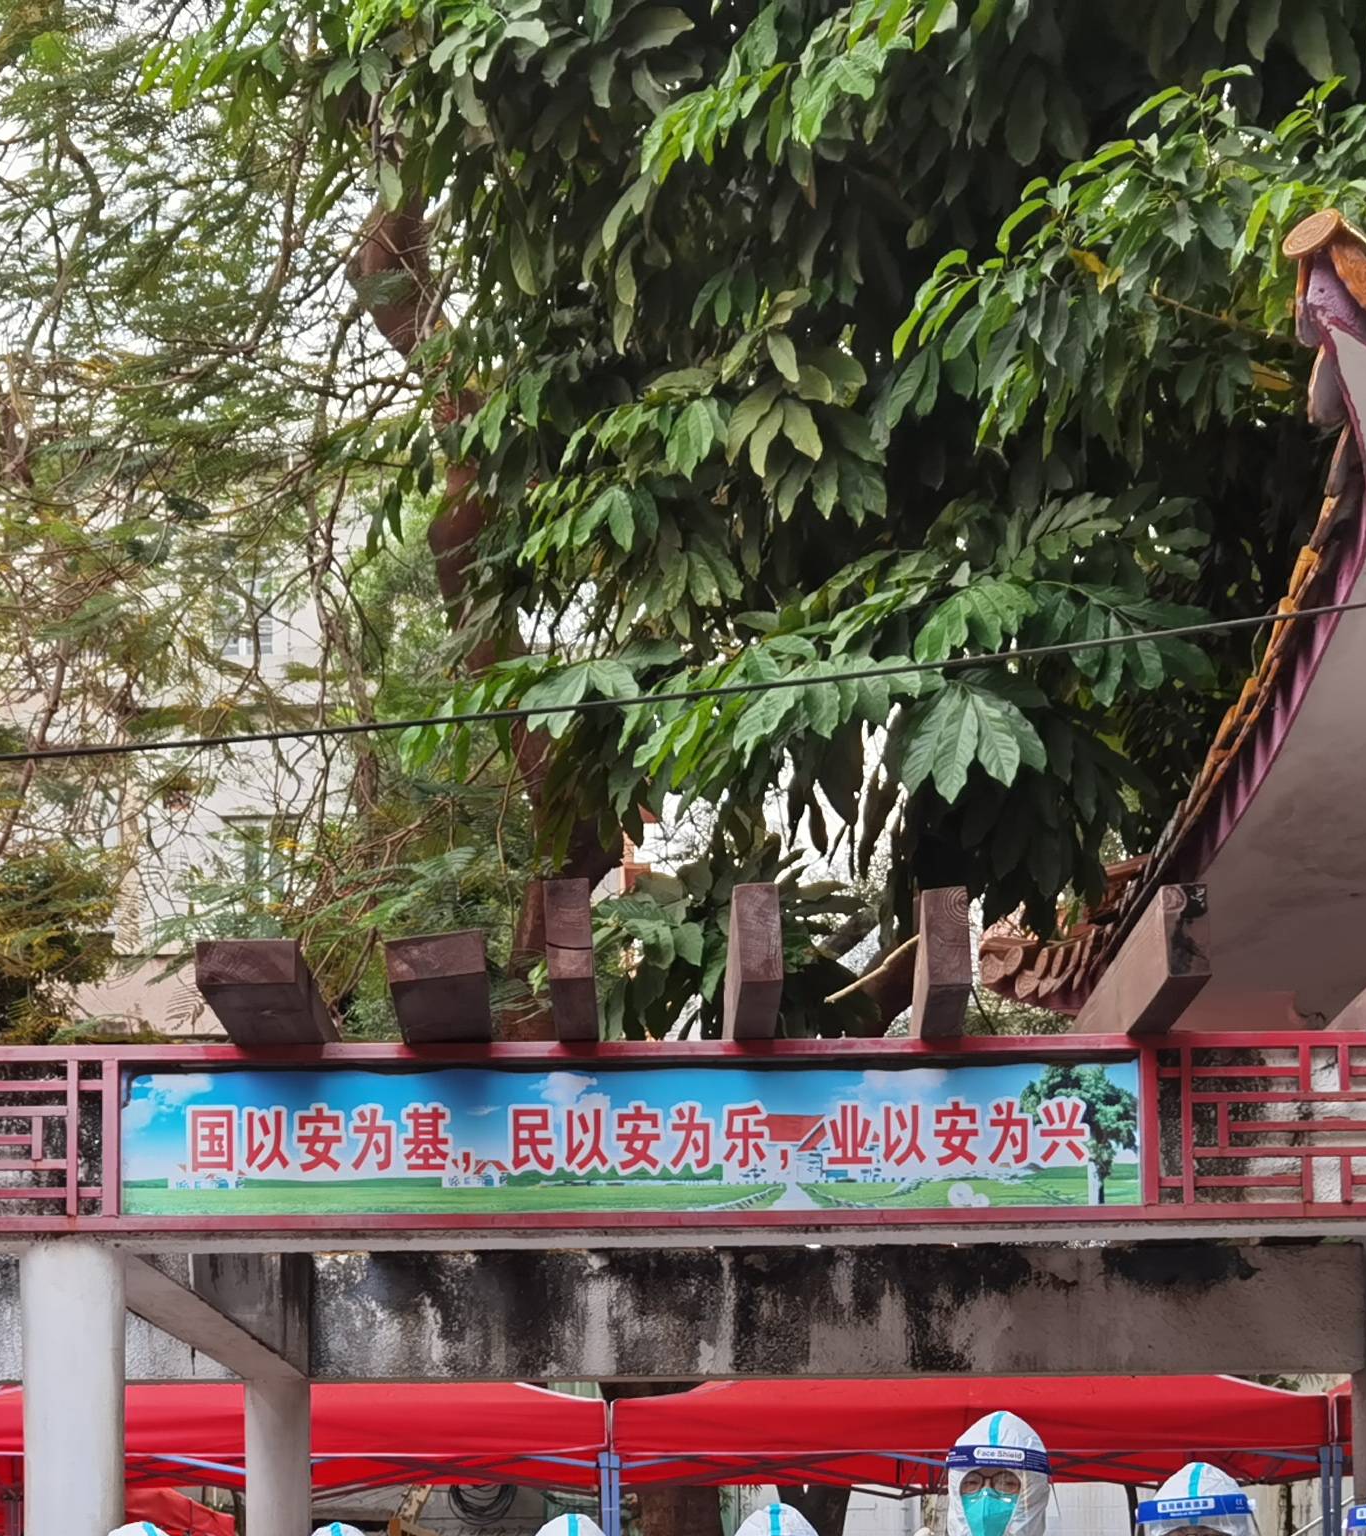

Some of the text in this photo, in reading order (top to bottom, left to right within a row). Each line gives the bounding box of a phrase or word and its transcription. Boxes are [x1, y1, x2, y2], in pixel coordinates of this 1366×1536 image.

[190, 1100, 1086, 1173] 国以安为基，民以安为乐，业以安为兴
